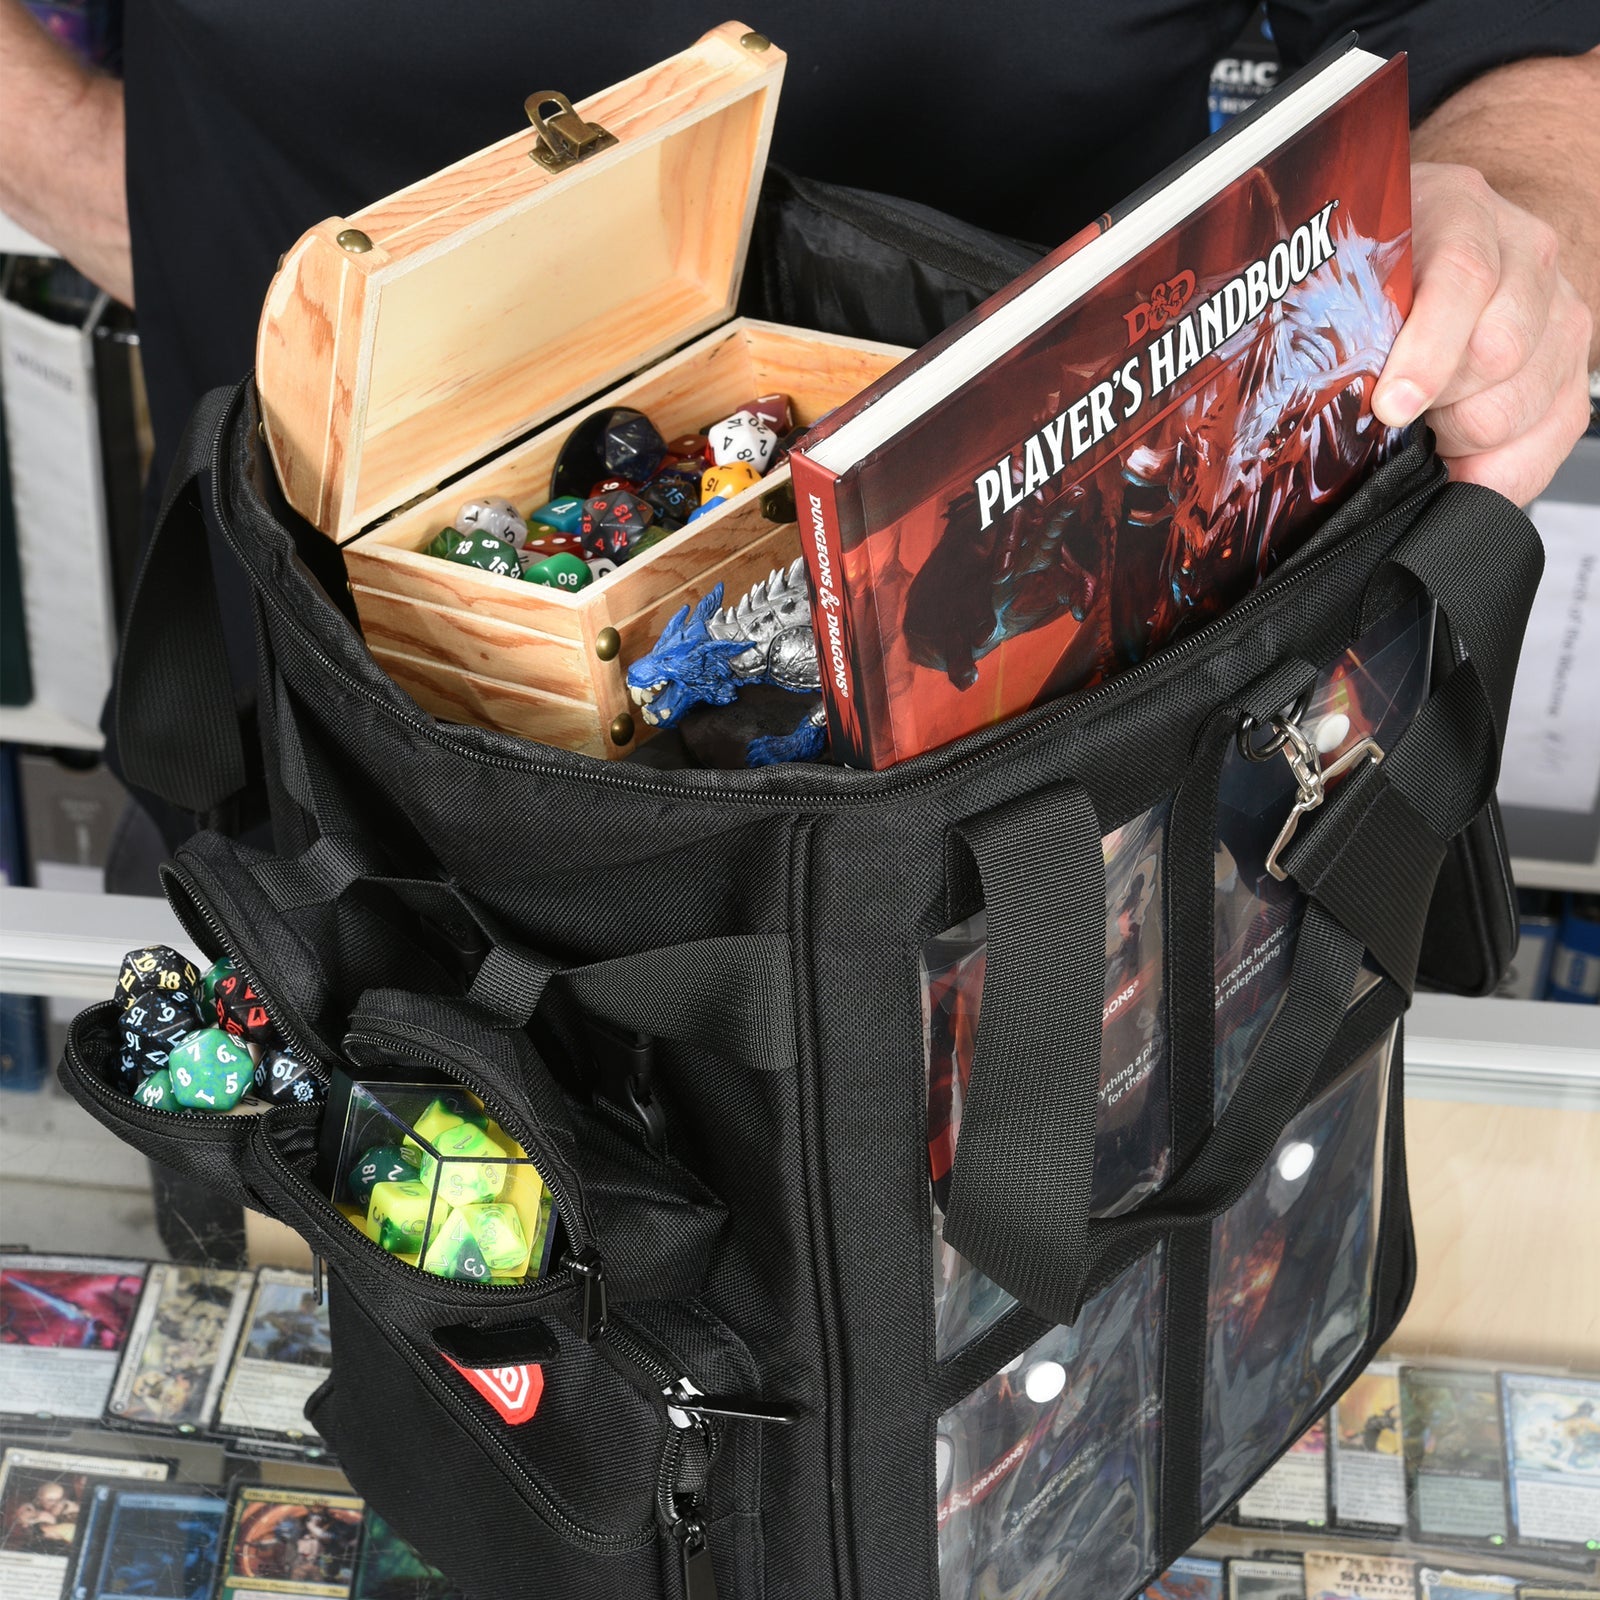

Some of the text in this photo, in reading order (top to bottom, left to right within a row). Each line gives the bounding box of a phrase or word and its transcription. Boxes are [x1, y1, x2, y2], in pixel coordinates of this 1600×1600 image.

[1209, 58, 1279, 88] GIC
[1123, 269, 1196, 349] D&D
[723, 436, 734, 451] 4
[974, 355, 1144, 532] PLAYER’S
[551, 502, 578, 515] 4
[503, 526, 516, 544] 5
[808, 493, 834, 589] DUNGEONS
[819, 587, 840, 612] &
[133, 952, 158, 973] 19
[1221, 955, 1253, 988] create
[1253, 925, 1285, 959] heroic
[157, 969, 181, 990] 18
[1225, 944, 1281, 999] roleplaying
[176, 1067, 192, 1088] 8
[225, 1072, 239, 1095] 5
[1099, 1063, 1135, 1101] ything
[1108, 1086, 1124, 1107] for
[1124, 1070, 1143, 1095] the
[361, 1163, 377, 1185] 18
[463, 1257, 486, 1278] 3
